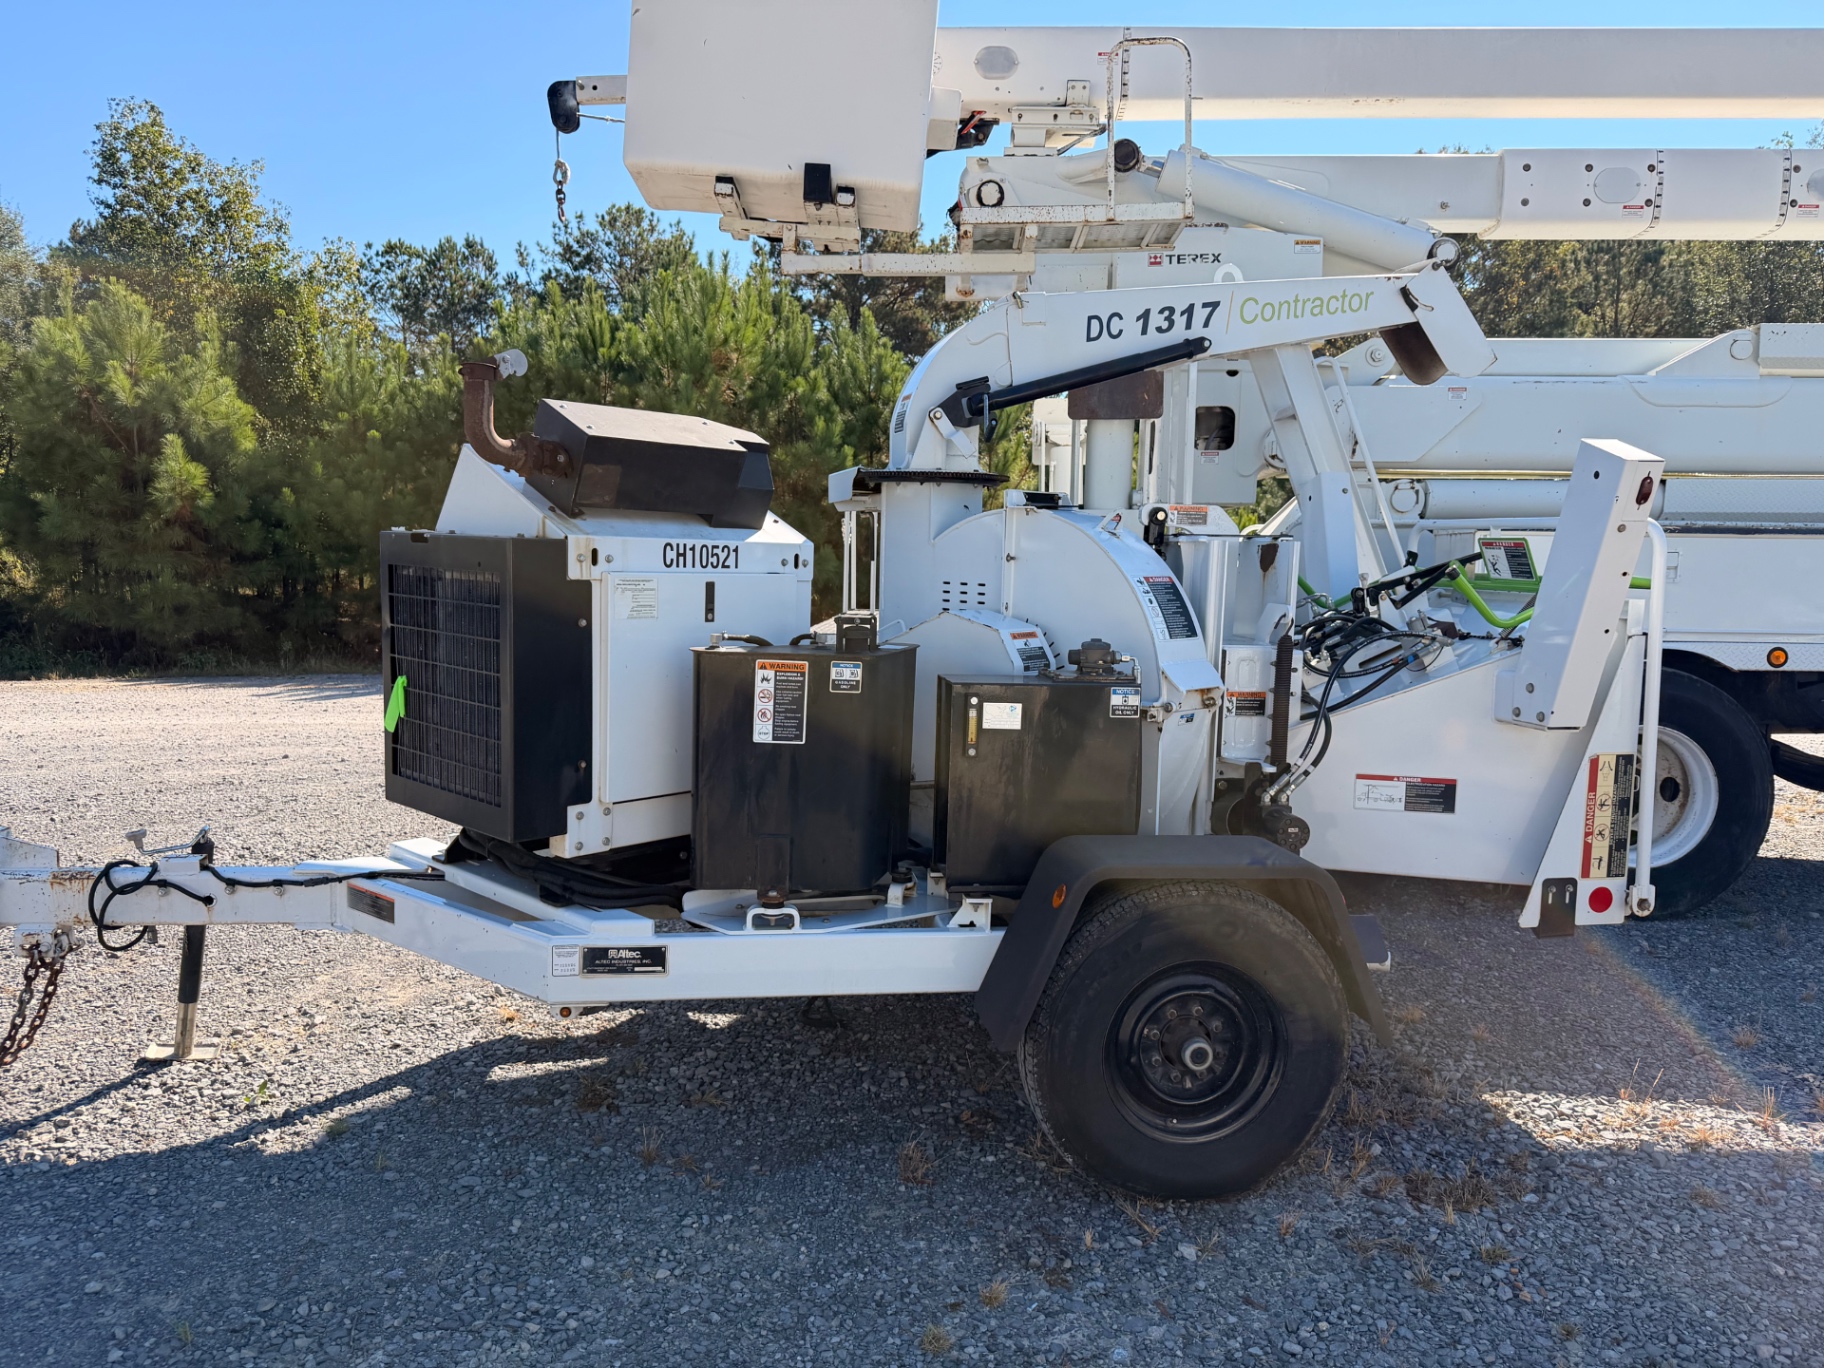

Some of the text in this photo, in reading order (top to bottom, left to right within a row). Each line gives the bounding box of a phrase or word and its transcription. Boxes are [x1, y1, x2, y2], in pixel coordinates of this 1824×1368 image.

[1165, 253, 1222, 265] TEREX
[1085, 289, 1375, 343] DC 1317 Contractor
[662, 542, 739, 569] CH10521
[1585, 792, 1596, 832] DANGER
[617, 949, 642, 959] Altec
